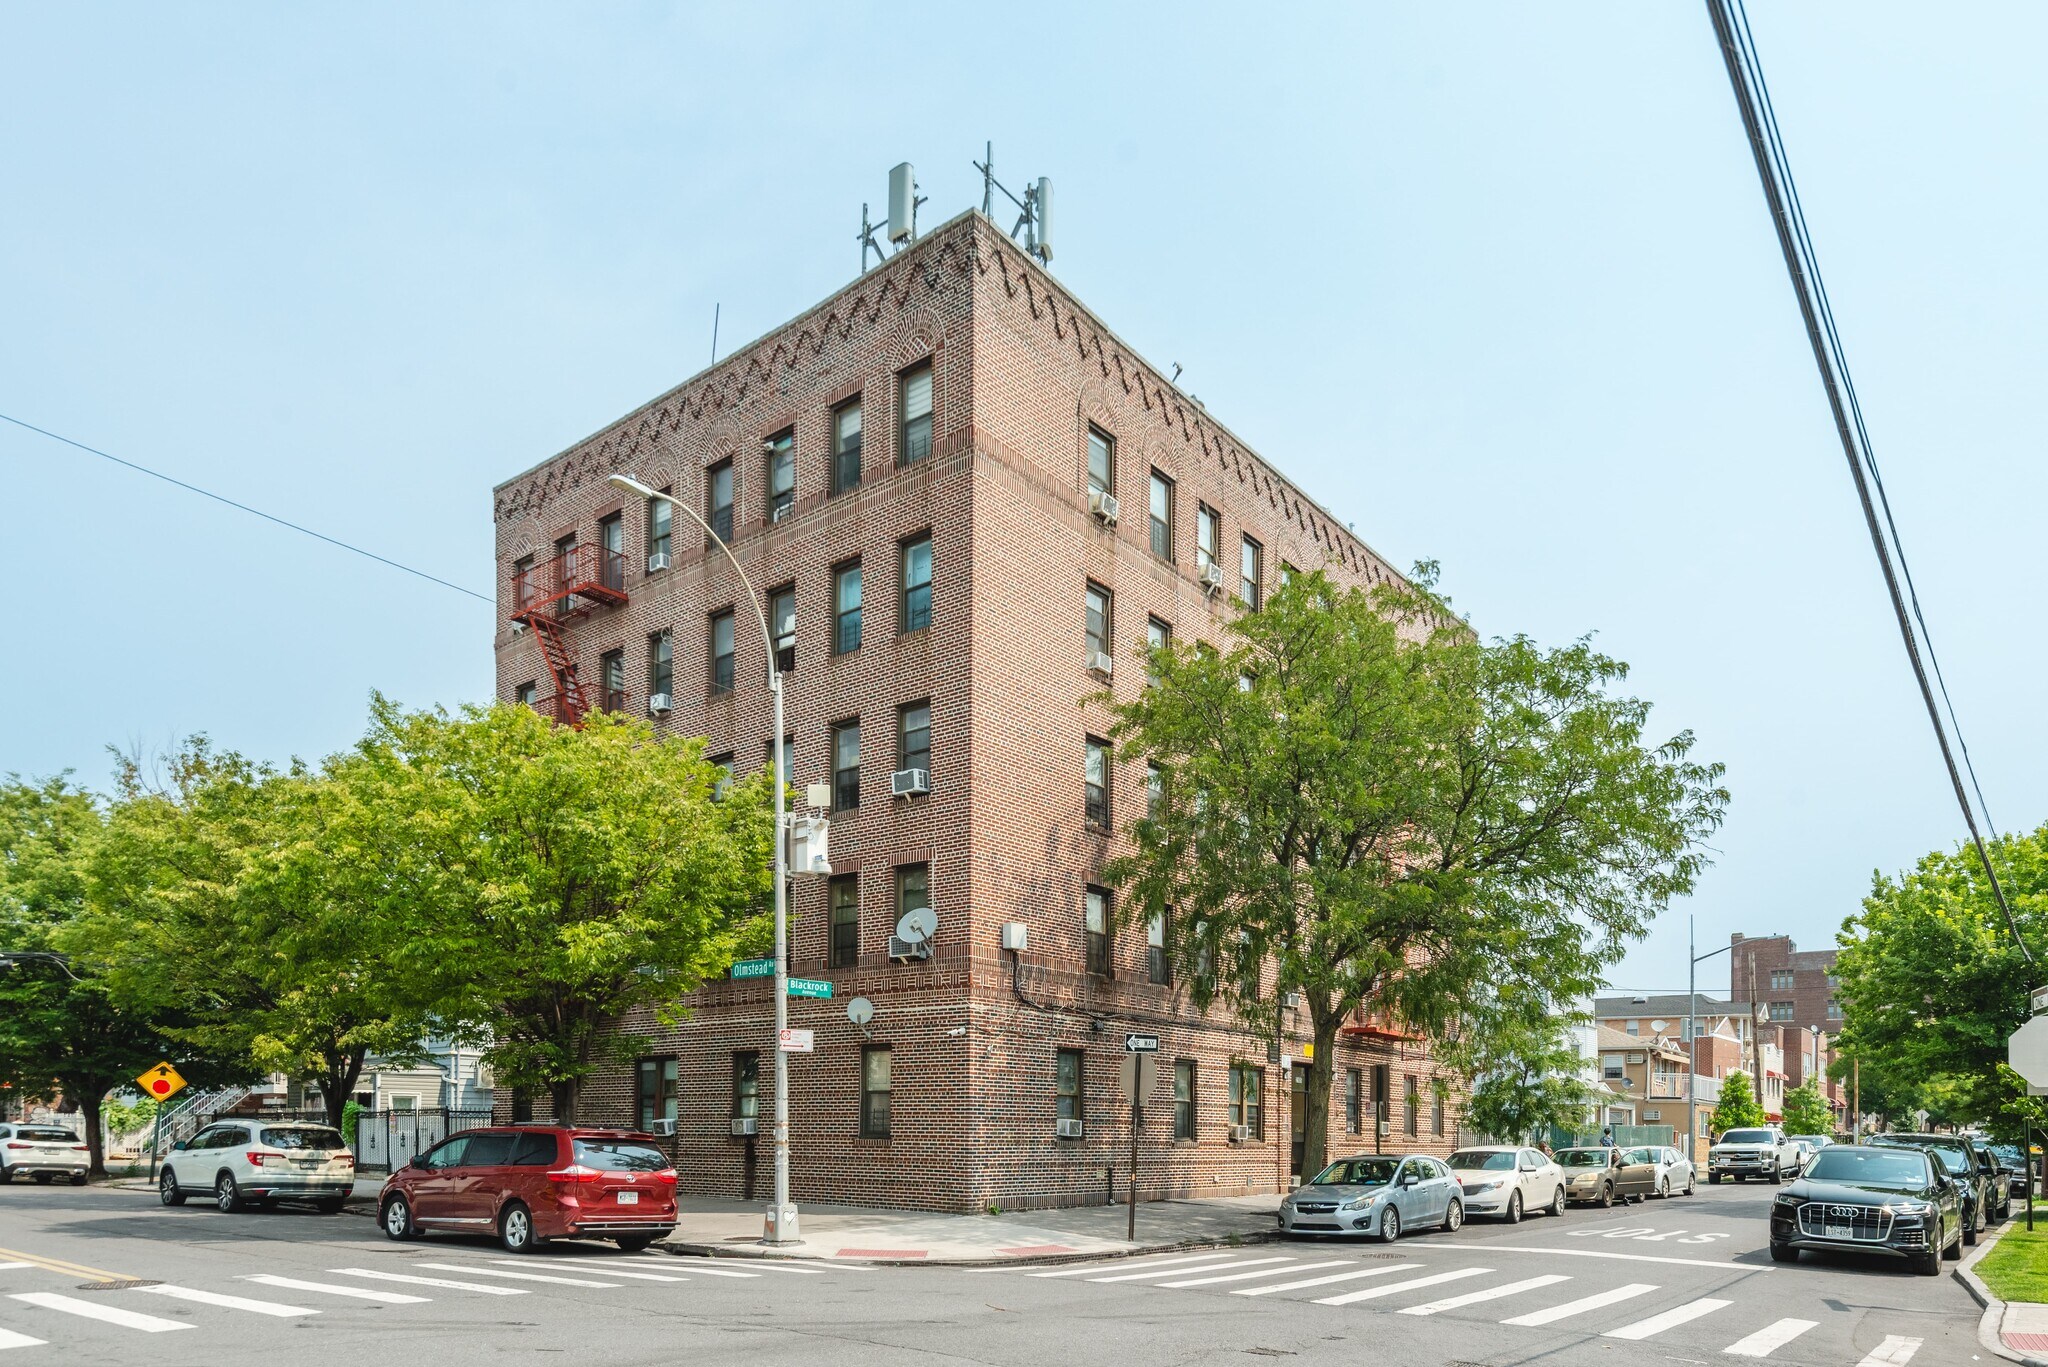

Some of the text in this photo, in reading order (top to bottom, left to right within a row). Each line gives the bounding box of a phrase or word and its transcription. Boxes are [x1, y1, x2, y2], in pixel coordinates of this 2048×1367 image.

[734, 961, 768, 977] Olmstead
[790, 980, 828, 992] Blackrock
[1566, 1227, 1731, 1244] STOP
